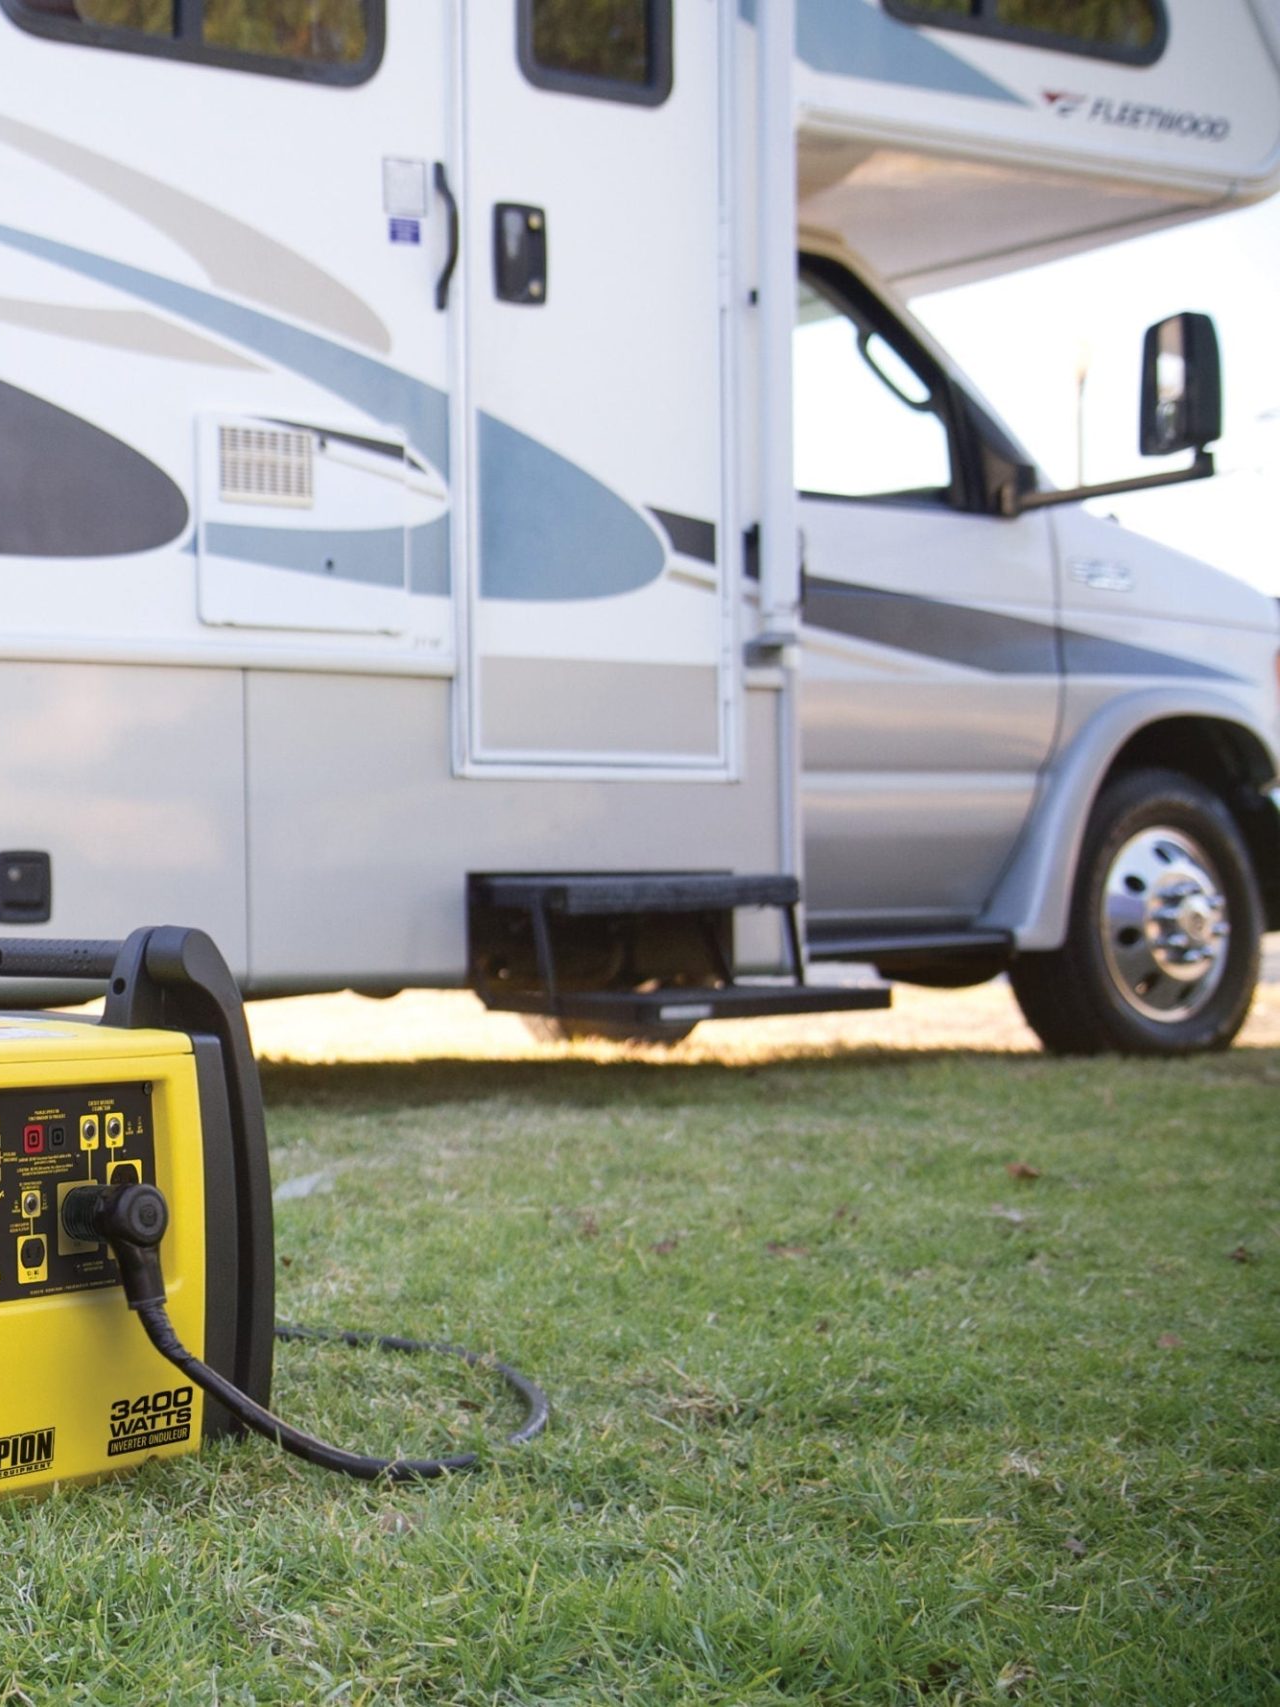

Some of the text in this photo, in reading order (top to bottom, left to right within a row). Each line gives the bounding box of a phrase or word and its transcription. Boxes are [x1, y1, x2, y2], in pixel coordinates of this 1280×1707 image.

[1090, 96, 1230, 142] FLEETWOOD
[110, 1386, 193, 1421] 3400
[109, 1407, 192, 1438] WATTS
[111, 1427, 188, 1453] INVERTER ONDULEUR
